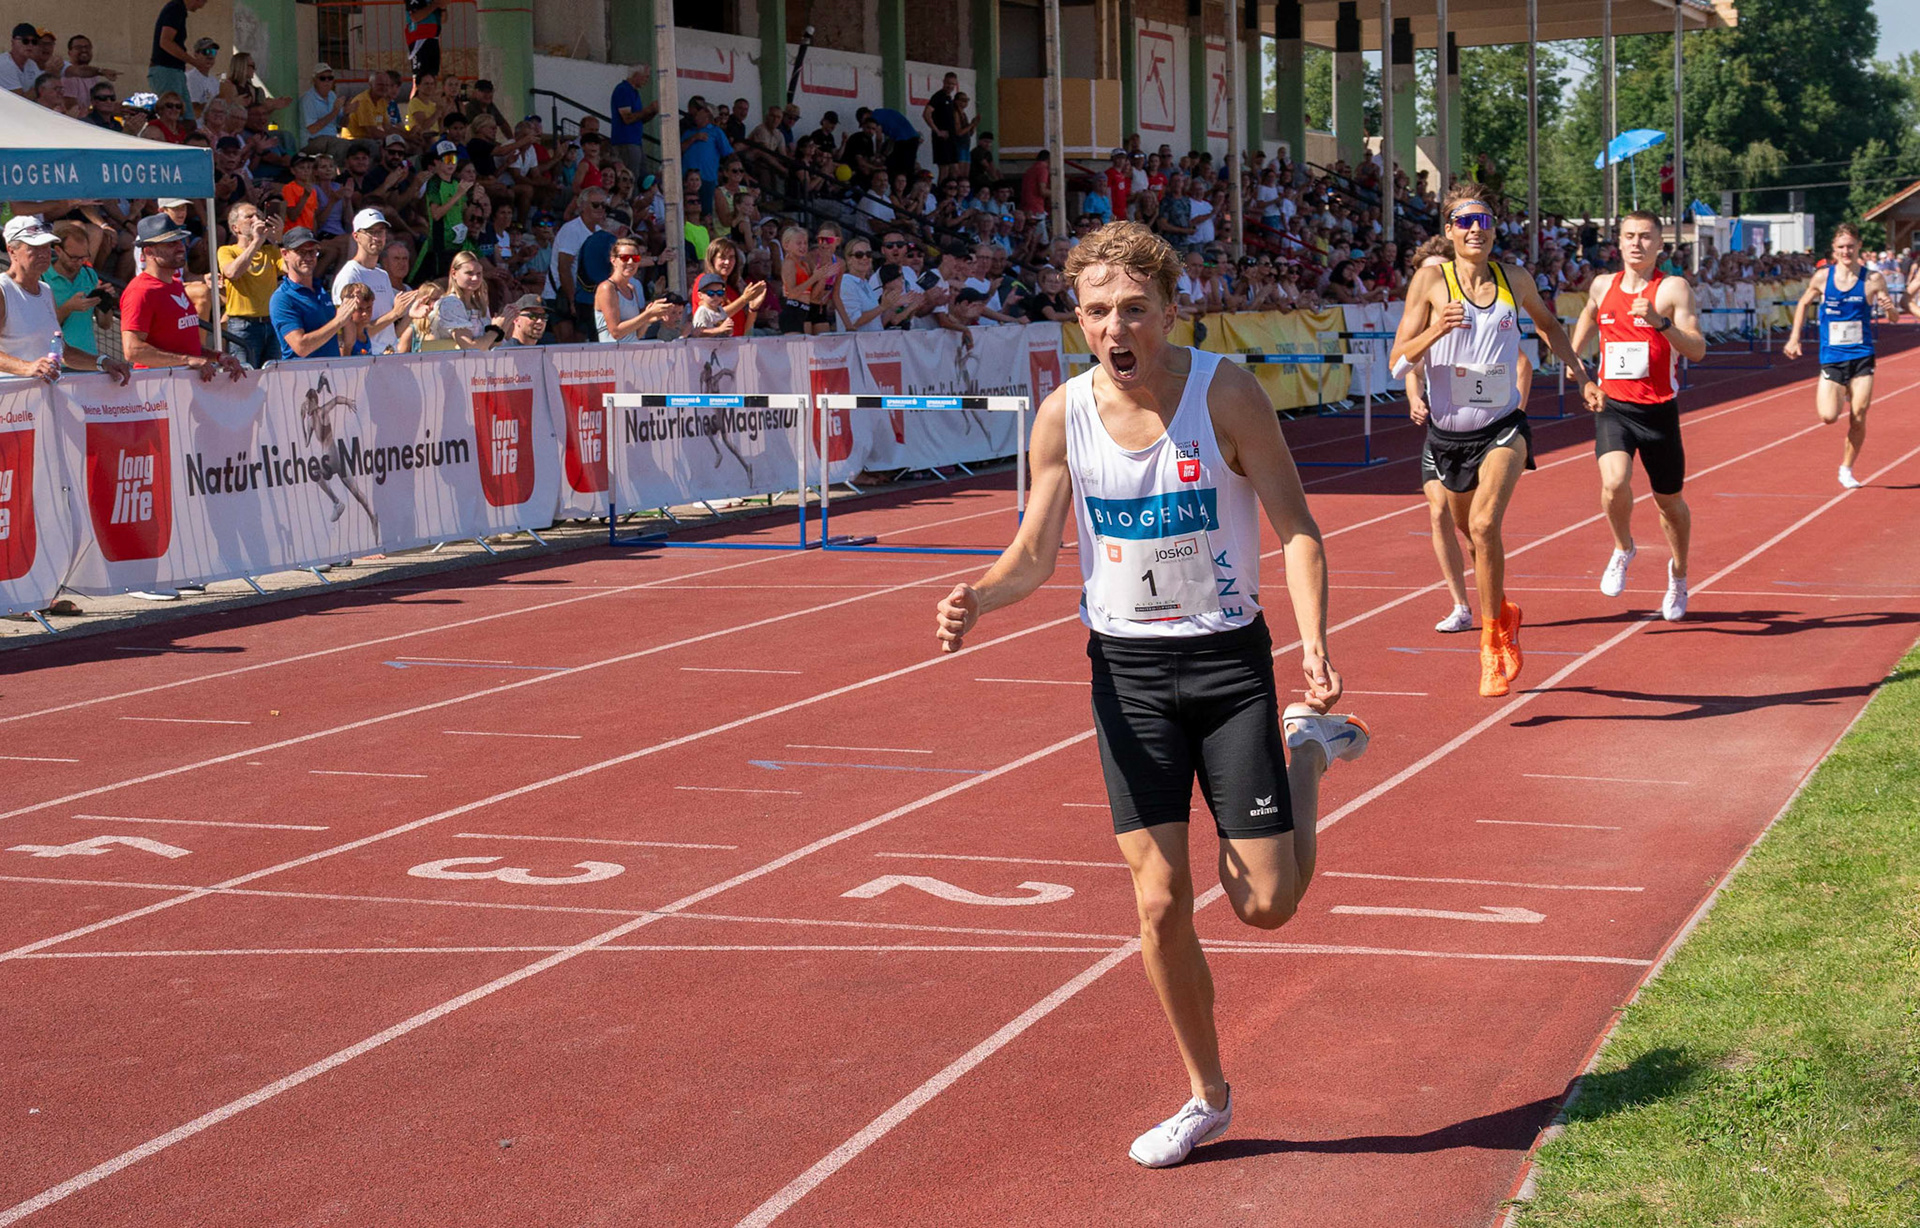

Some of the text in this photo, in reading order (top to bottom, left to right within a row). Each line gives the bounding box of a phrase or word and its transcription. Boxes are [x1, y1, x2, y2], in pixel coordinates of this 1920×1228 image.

[2, 162, 183, 185] IOGENA BIOGENA
[178, 313, 200, 330] erim
[1620, 356, 1625, 368] 3
[1475, 380, 1483, 395] 5
[492, 414, 519, 444] long
[578, 406, 602, 434] long
[625, 407, 718, 444] Natürliches
[491, 440, 518, 476] life
[578, 430, 601, 464] life
[1176, 447, 1200, 459] IGLA
[118, 449, 154, 485] long
[186, 429, 470, 497] Natürliches Magnesium
[110, 481, 153, 525] life
[1094, 503, 1211, 528] BIOGENA
[1141, 569, 1158, 597] 1
[1250, 806, 1279, 817] erima
[5, 834, 194, 859] 4
[407, 856, 626, 885] 3
[839, 874, 1075, 906] 2
[1330, 905, 1548, 924] 1
